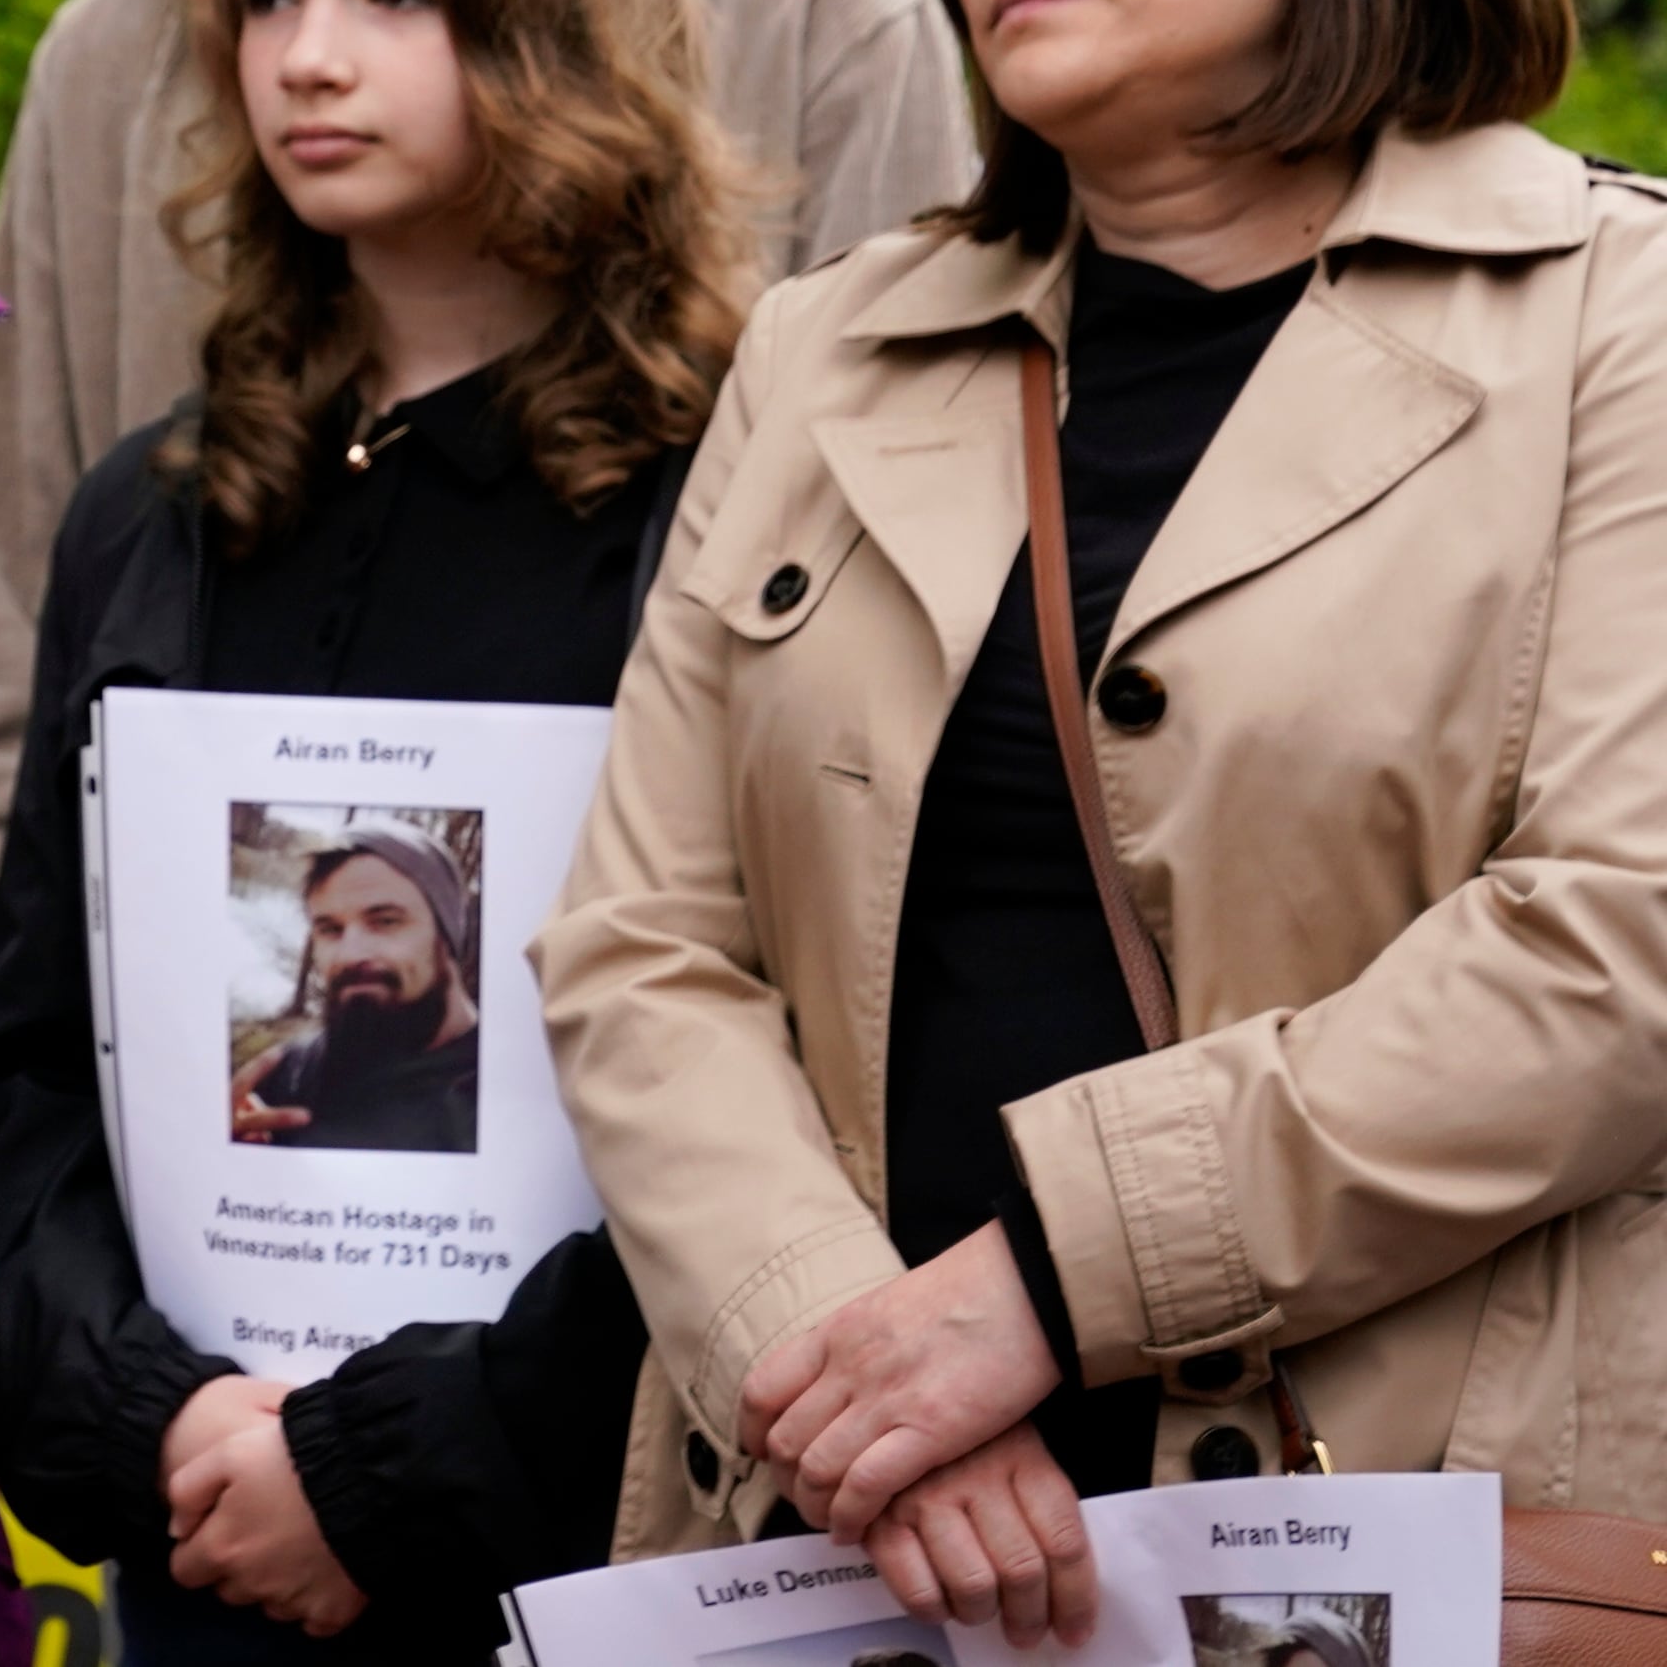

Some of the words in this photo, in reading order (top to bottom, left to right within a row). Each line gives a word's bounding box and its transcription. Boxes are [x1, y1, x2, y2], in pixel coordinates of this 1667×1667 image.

[274, 736, 349, 761] Airan
[359, 738, 435, 770] Berry
[216, 1195, 334, 1229] American
[342, 1205, 460, 1237] Hostage
[469, 1209, 495, 1233] in
[204, 1229, 325, 1264] Venezuela
[334, 1241, 372, 1265] for
[382, 1243, 427, 1267] 731
[440, 1244, 511, 1275] Days
[233, 1317, 297, 1352] Bring
[1210, 1521, 1278, 1548] Airan
[1285, 1519, 1351, 1552] Berry
[696, 1578, 769, 1607] Luke
[775, 1561, 879, 1593] Denma
